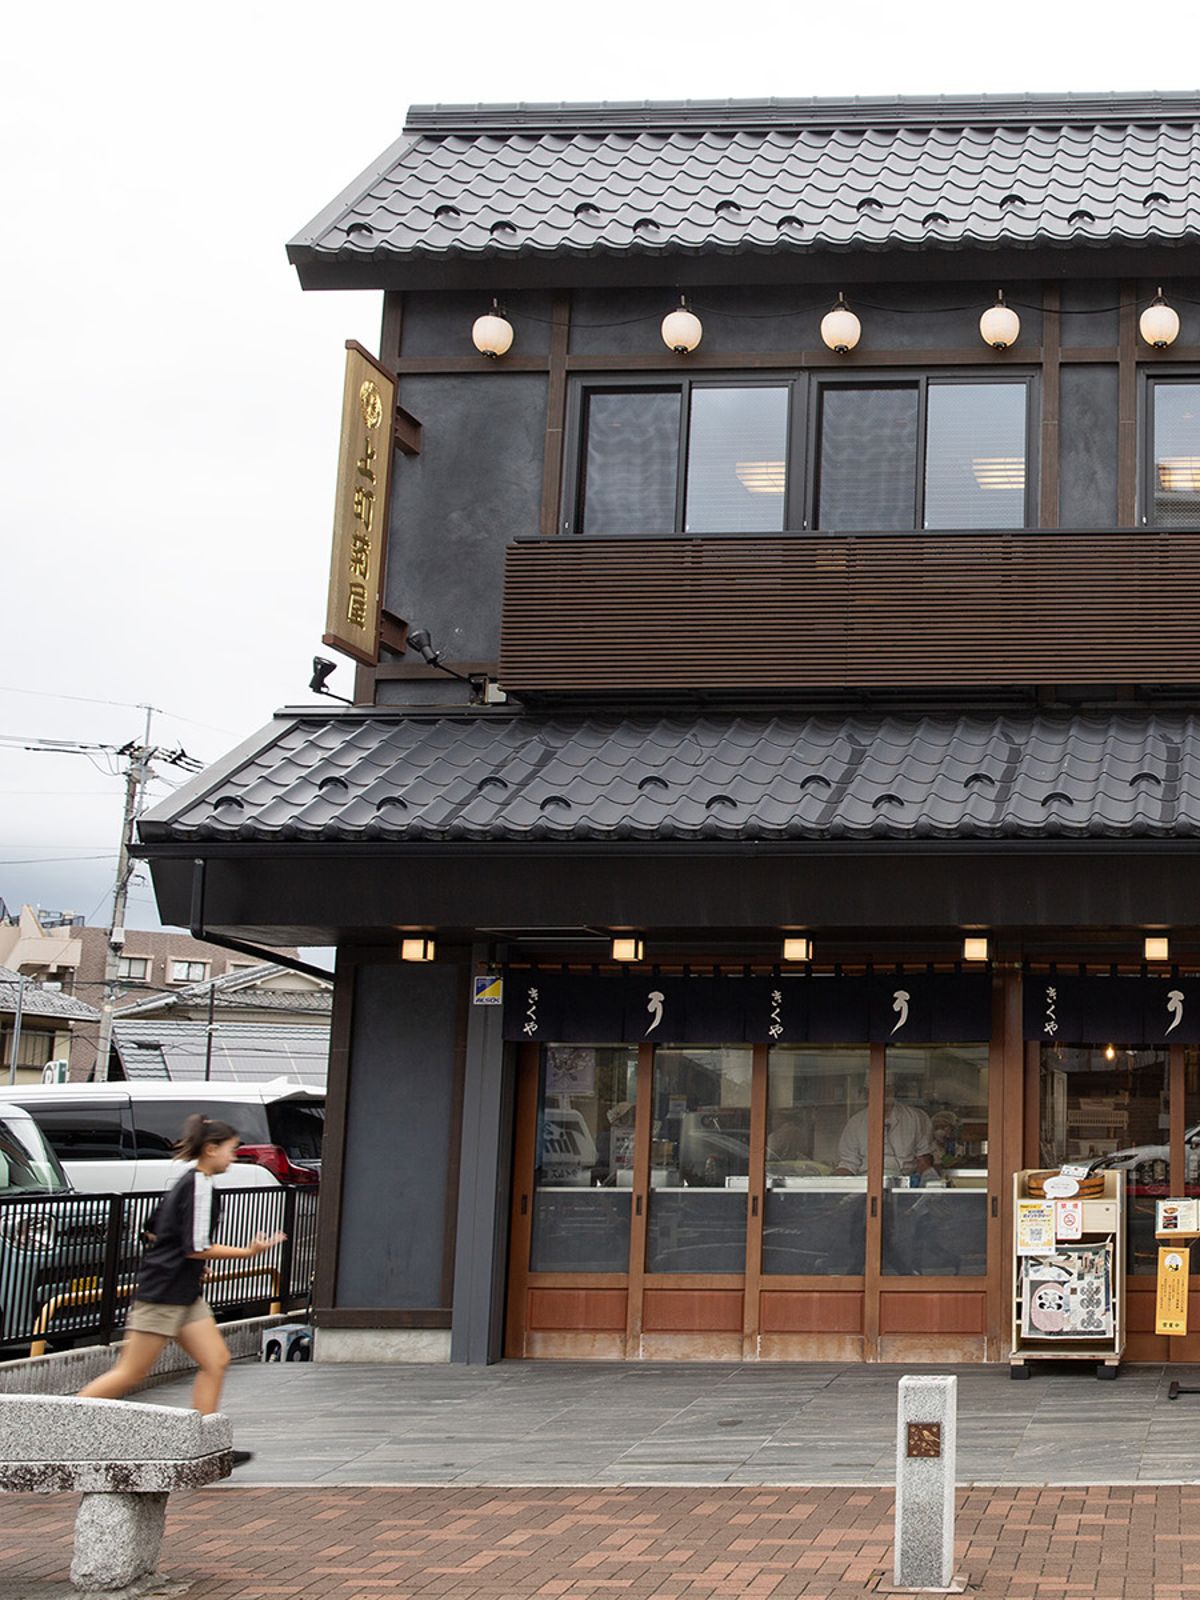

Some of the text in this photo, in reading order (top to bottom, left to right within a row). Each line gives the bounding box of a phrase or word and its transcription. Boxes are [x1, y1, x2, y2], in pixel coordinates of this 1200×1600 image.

[523, 988, 537, 1035] きくや
[769, 991, 783, 1038] きくや
[1044, 987, 1058, 1035] きくや
